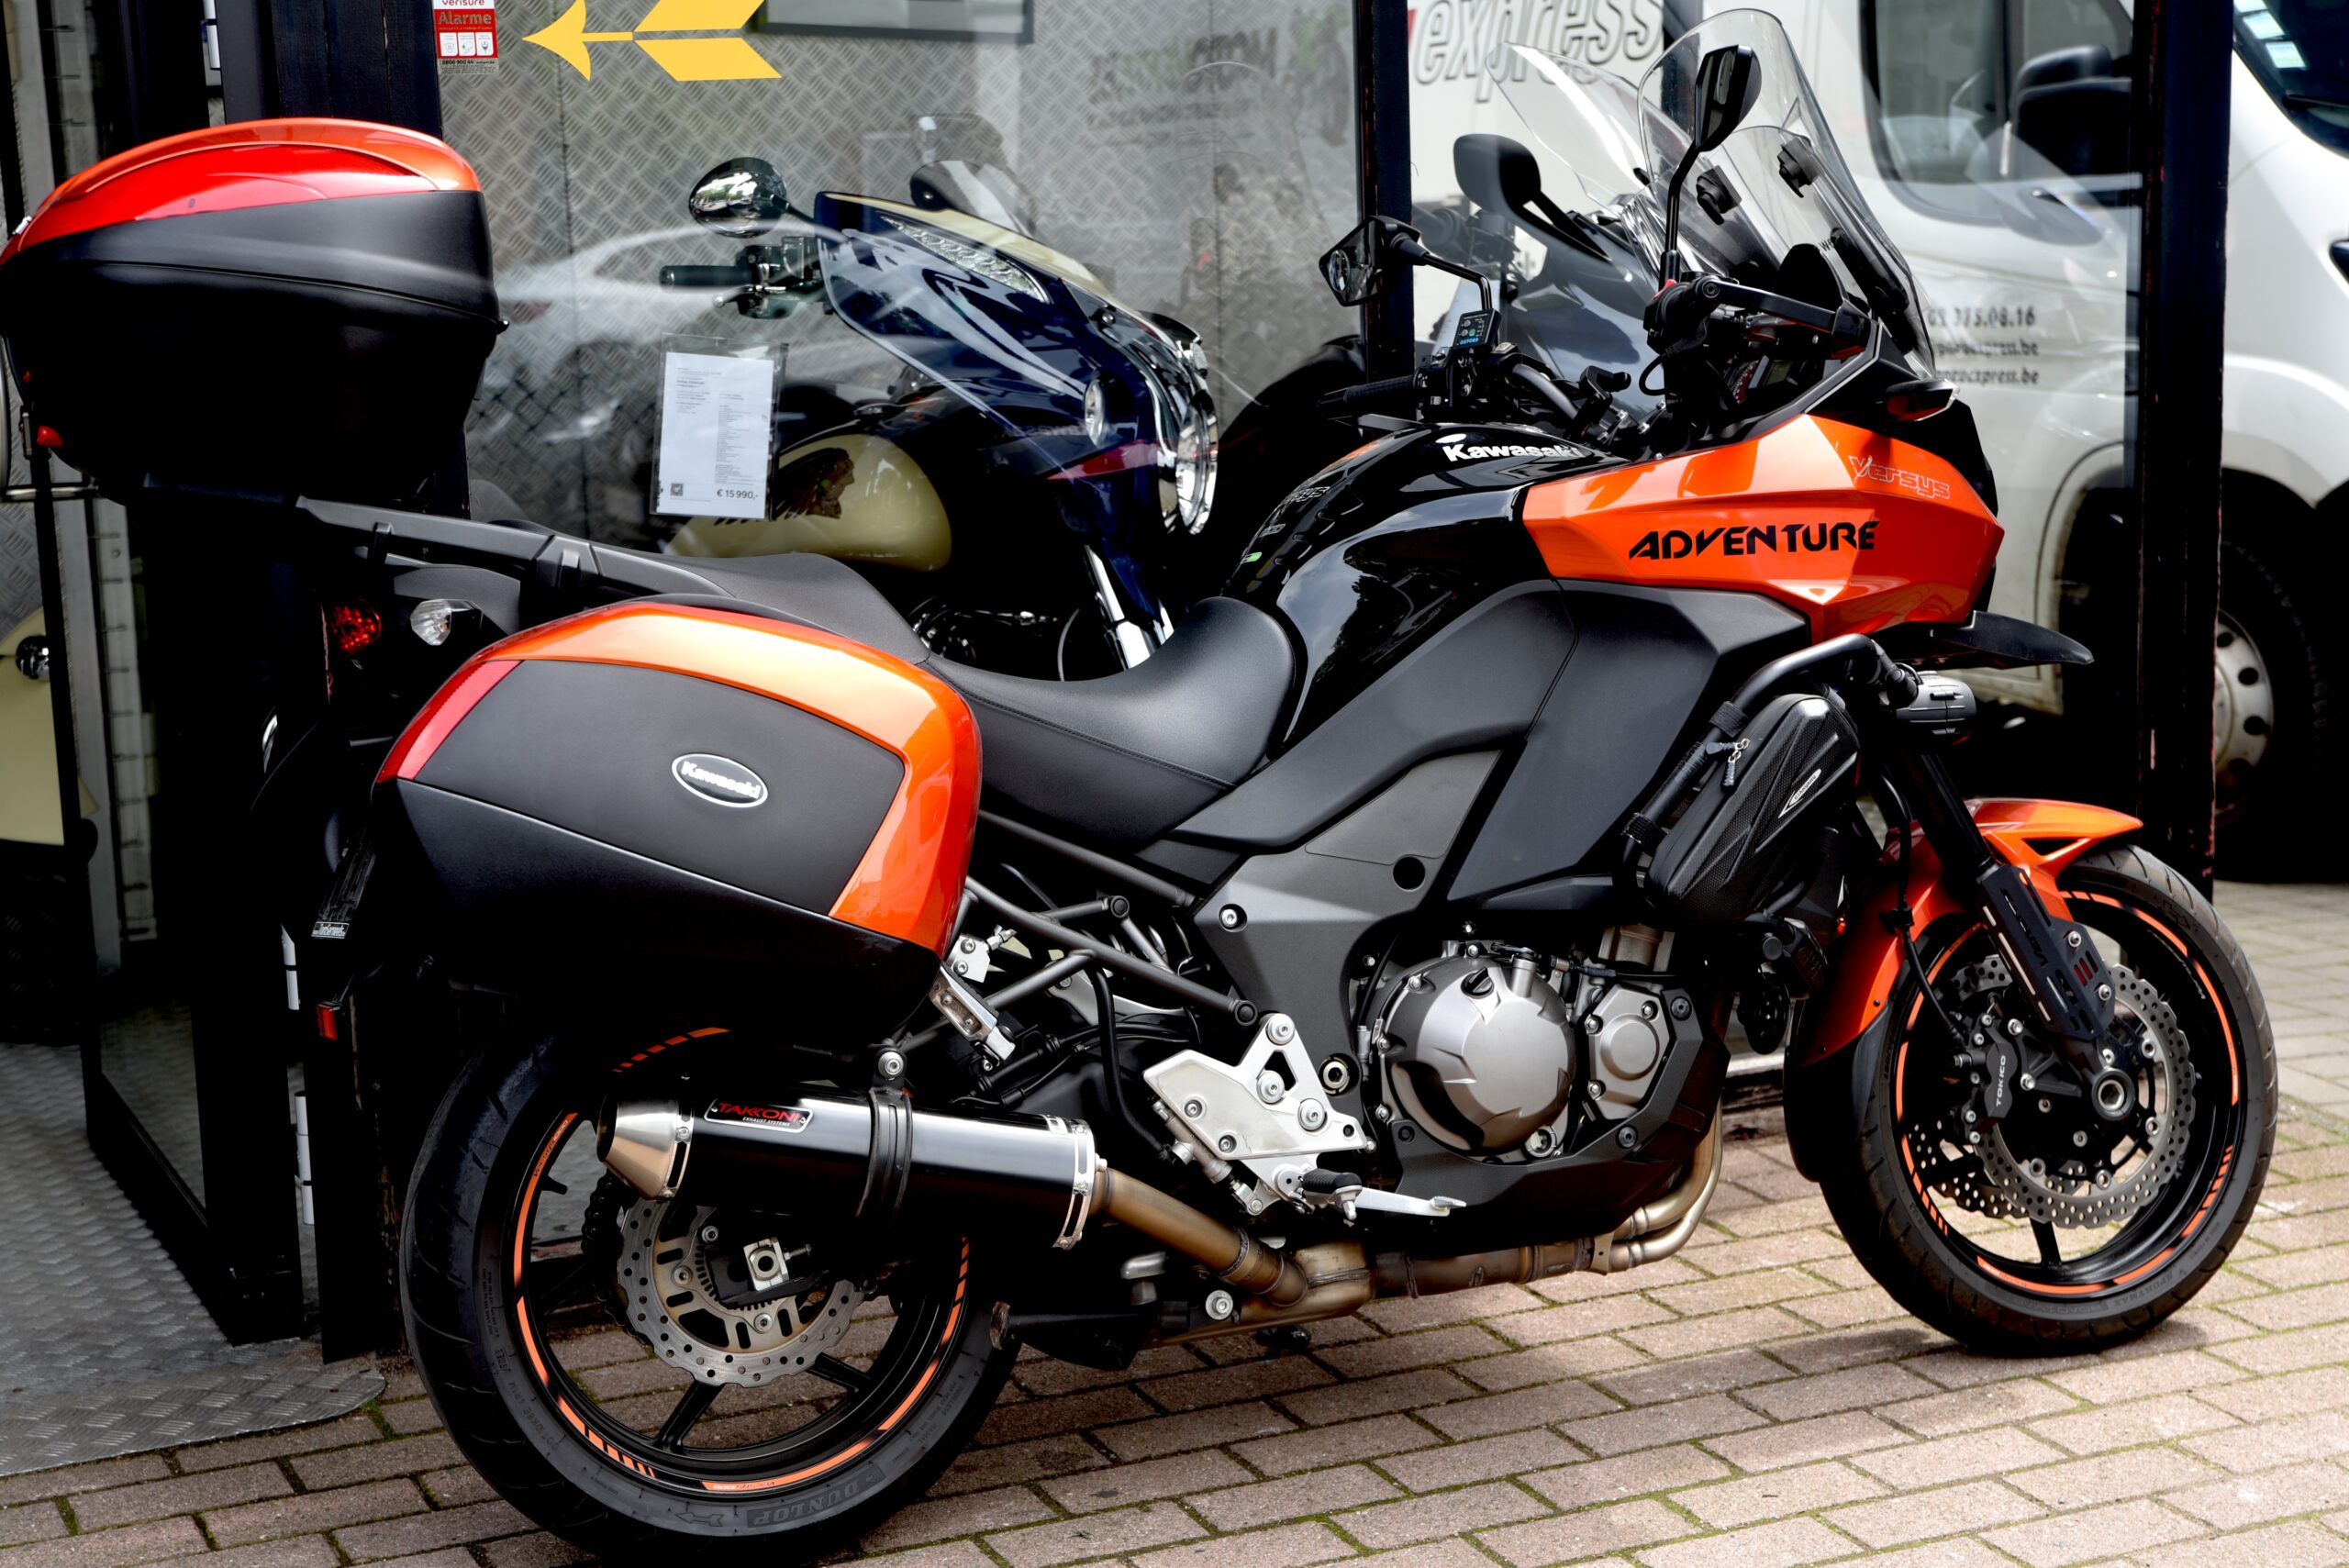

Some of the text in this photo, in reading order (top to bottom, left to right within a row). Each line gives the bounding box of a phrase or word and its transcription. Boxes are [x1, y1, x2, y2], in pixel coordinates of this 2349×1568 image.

[438, 11, 492, 25] Alarme
[1413, 0, 1664, 103] express
[1442, 443, 1585, 462] Kawasaki
[1848, 455, 1950, 500] Versys
[1629, 520, 1879, 561] ADVENTURE
[1996, 1054, 2006, 1107] TOKICO
[752, 1481, 861, 1526] DUNLOP
